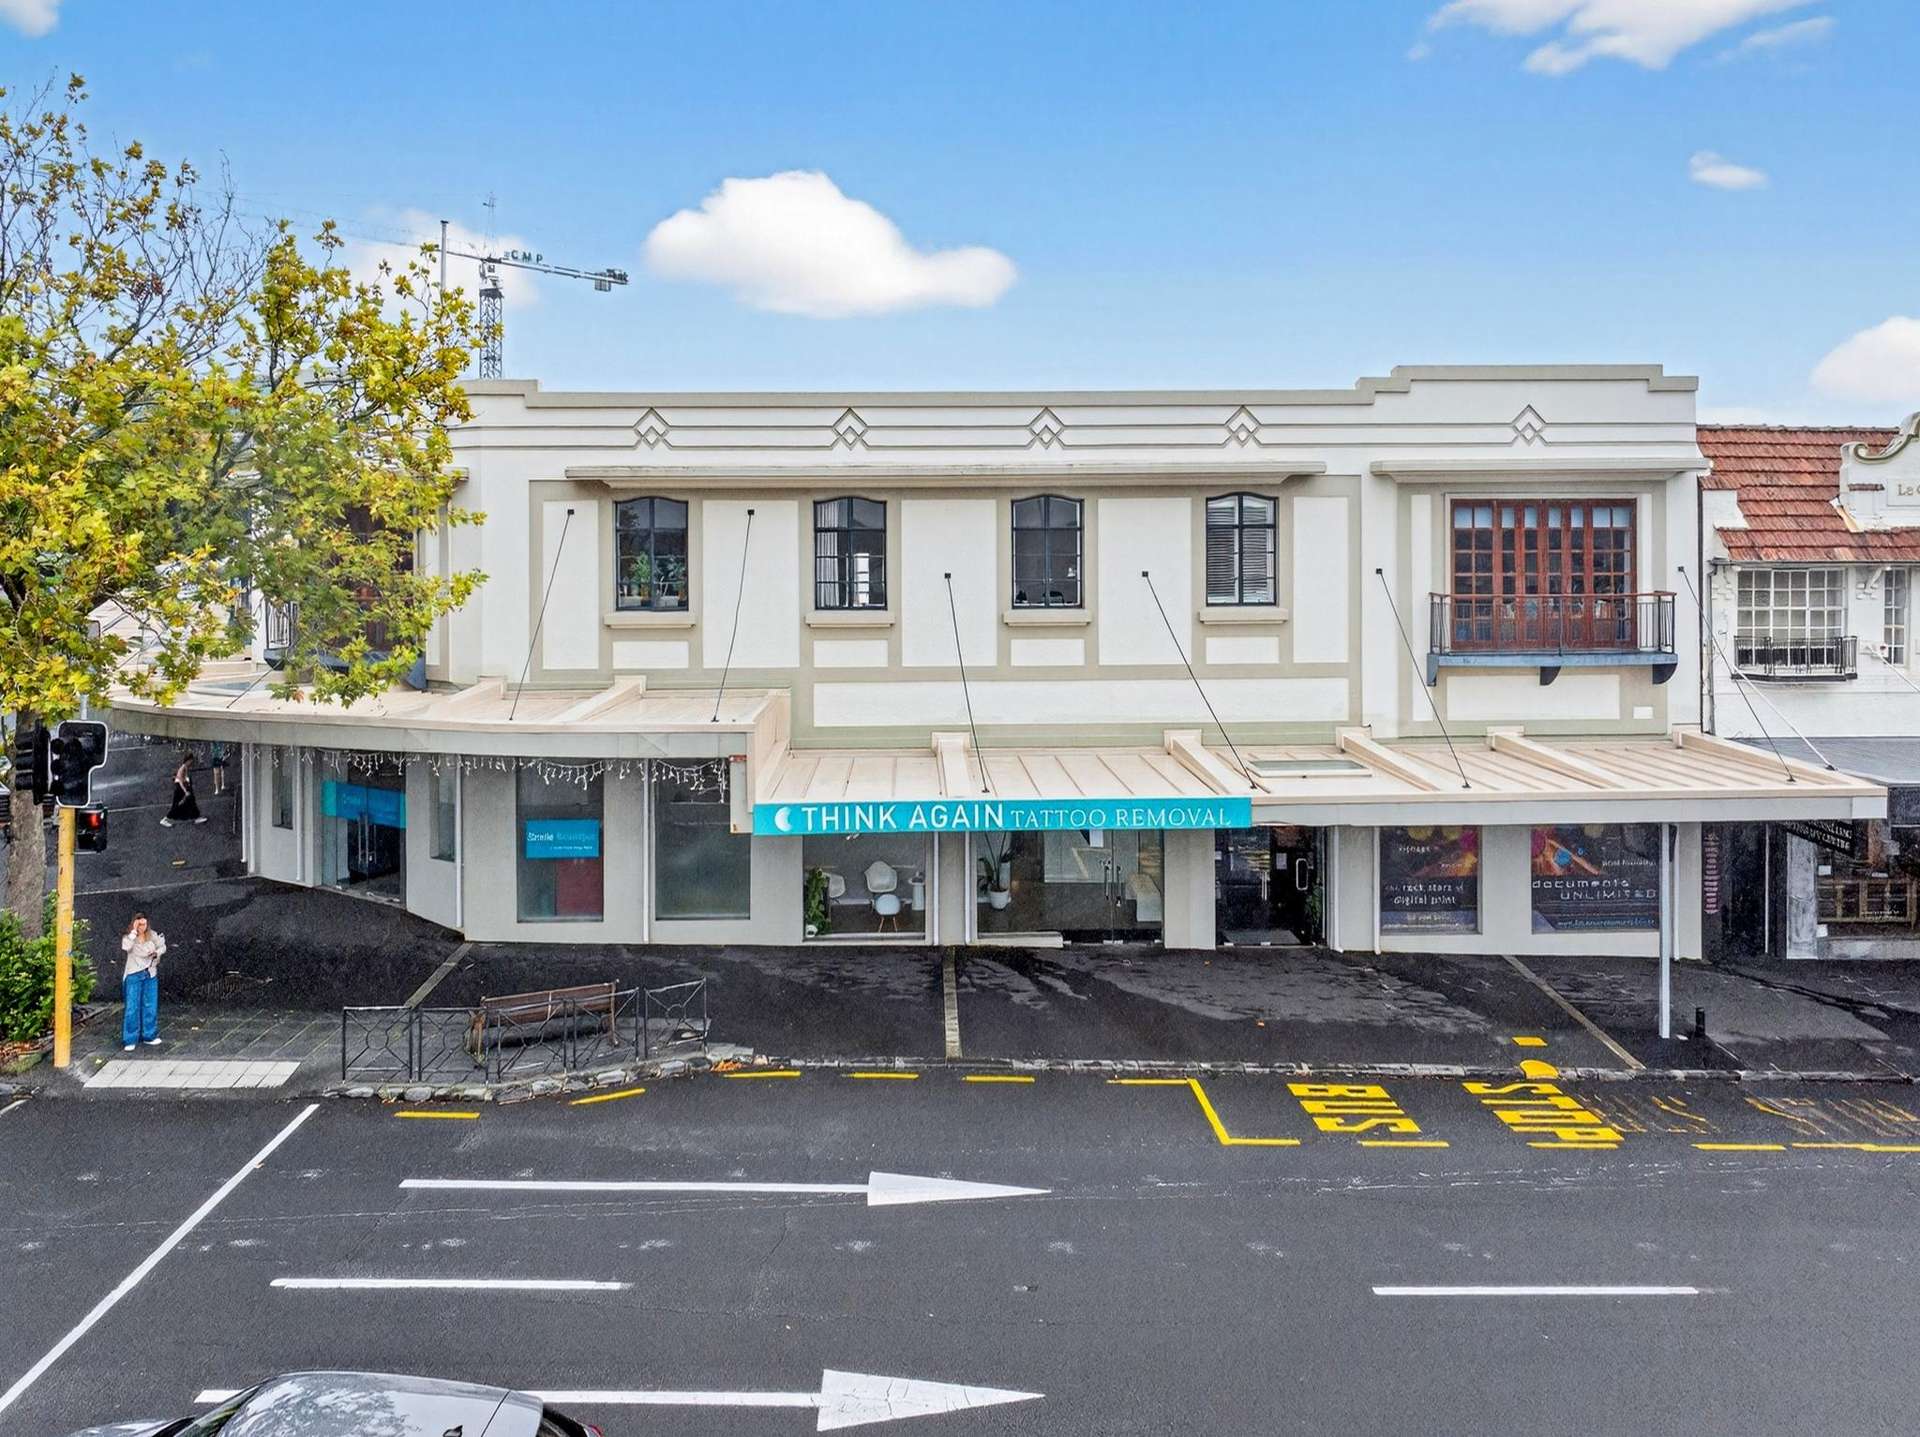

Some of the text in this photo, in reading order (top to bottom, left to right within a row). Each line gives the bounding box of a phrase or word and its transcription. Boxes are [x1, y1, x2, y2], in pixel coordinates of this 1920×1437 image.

[801, 804, 1232, 831] THINK AGAIN TATTOO REMOVAL
[1532, 879, 1630, 889] documents
[1560, 889, 1656, 900] UNLIMITED
[1286, 1083, 1423, 1133] BUS
[1462, 1082, 1626, 1141] STOP
